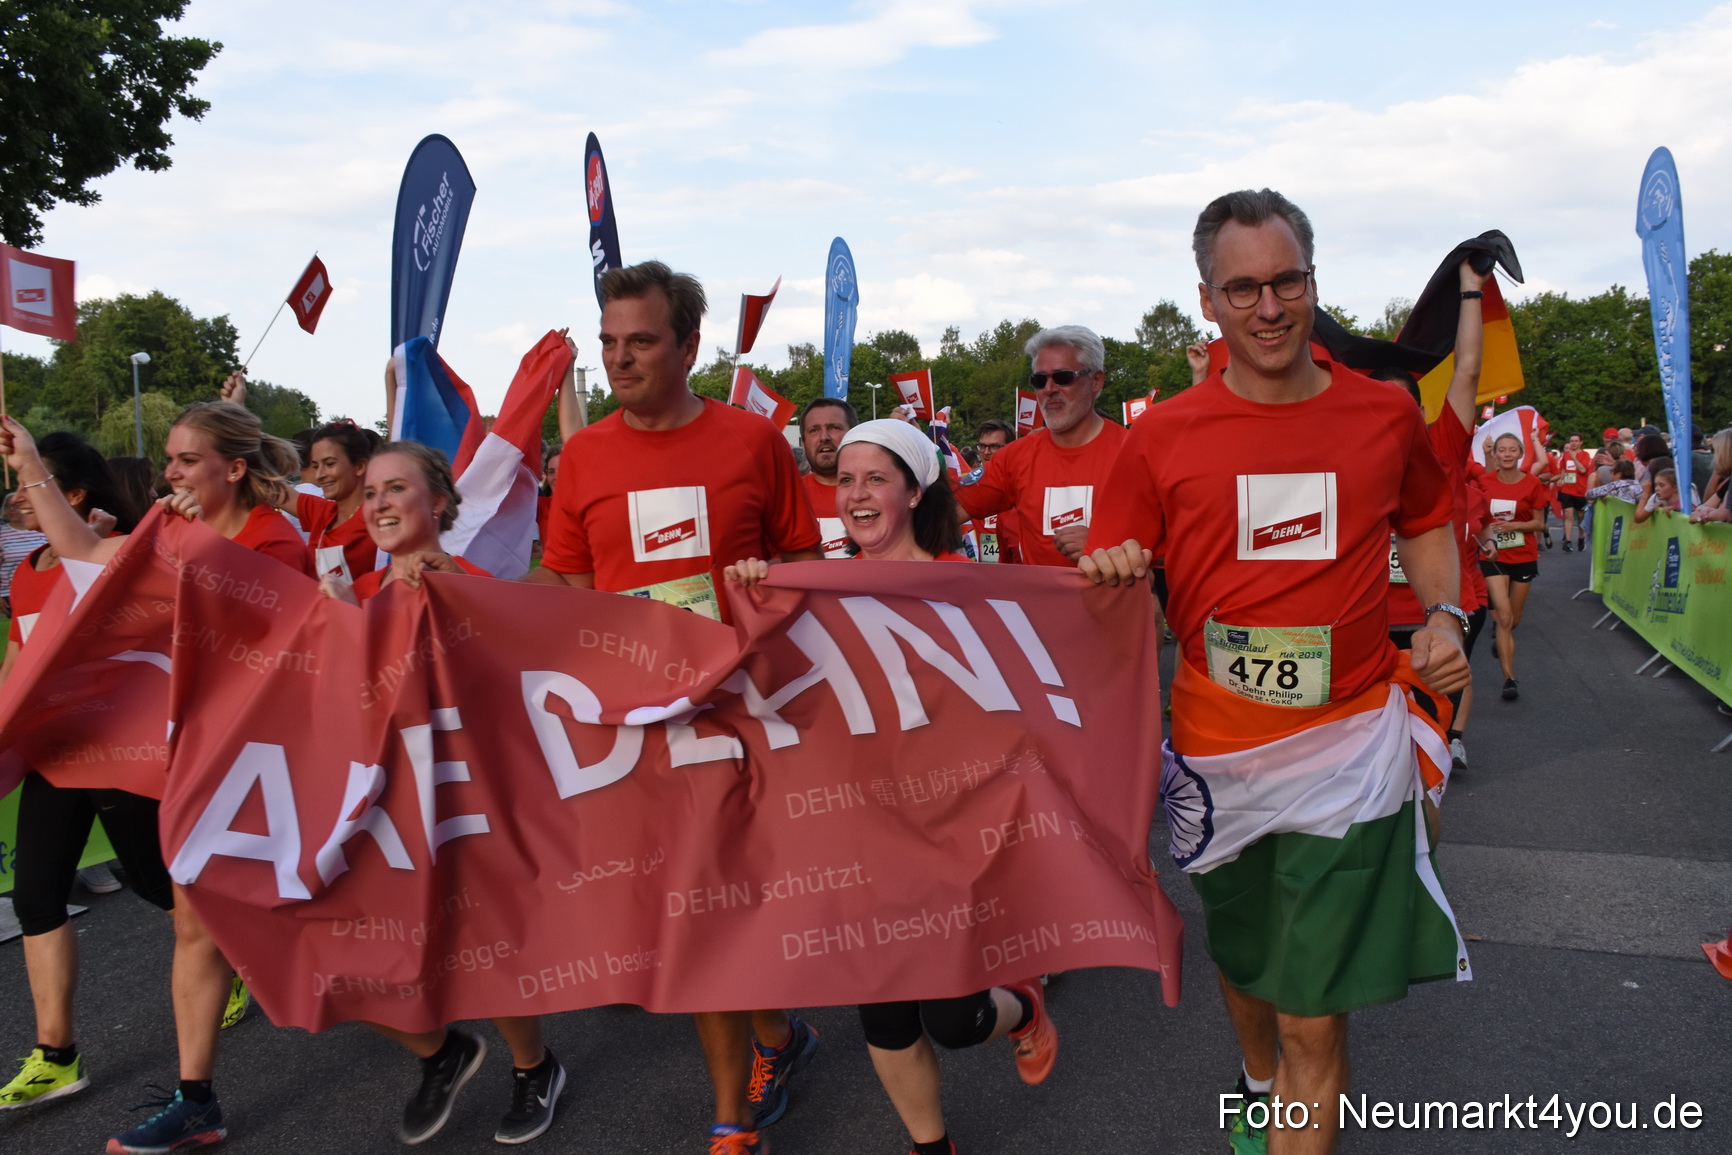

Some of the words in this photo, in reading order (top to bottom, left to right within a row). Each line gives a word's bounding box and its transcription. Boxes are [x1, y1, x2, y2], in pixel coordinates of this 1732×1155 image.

[421, 171, 449, 257] Fischer
[657, 528, 682, 544] DEHN
[1271, 523, 1303, 540] DEHN
[1497, 531, 1517, 543] 530
[1390, 551, 1401, 569] 5
[173, 621, 227, 653] EHN
[578, 628, 658, 673] DEHN
[664, 658, 709, 687] chr
[1298, 651, 1323, 659] 2019
[1228, 679, 1240, 689] Dr.
[1242, 684, 1266, 696] Dehn
[1268, 690, 1303, 700] Philipp
[1229, 656, 1299, 690] 478
[786, 782, 866, 820] DEHN
[979, 811, 1061, 856] DEHN
[557, 857, 636, 895] يحمي
[667, 881, 751, 918] DEHN
[761, 861, 872, 902] schützt.
[332, 916, 405, 942] DEHN
[782, 922, 866, 961] DEHN
[873, 897, 1006, 945] beskytter.
[982, 923, 1061, 972] DEHN
[314, 972, 387, 997] DEHN
[517, 955, 599, 999] DEHN
